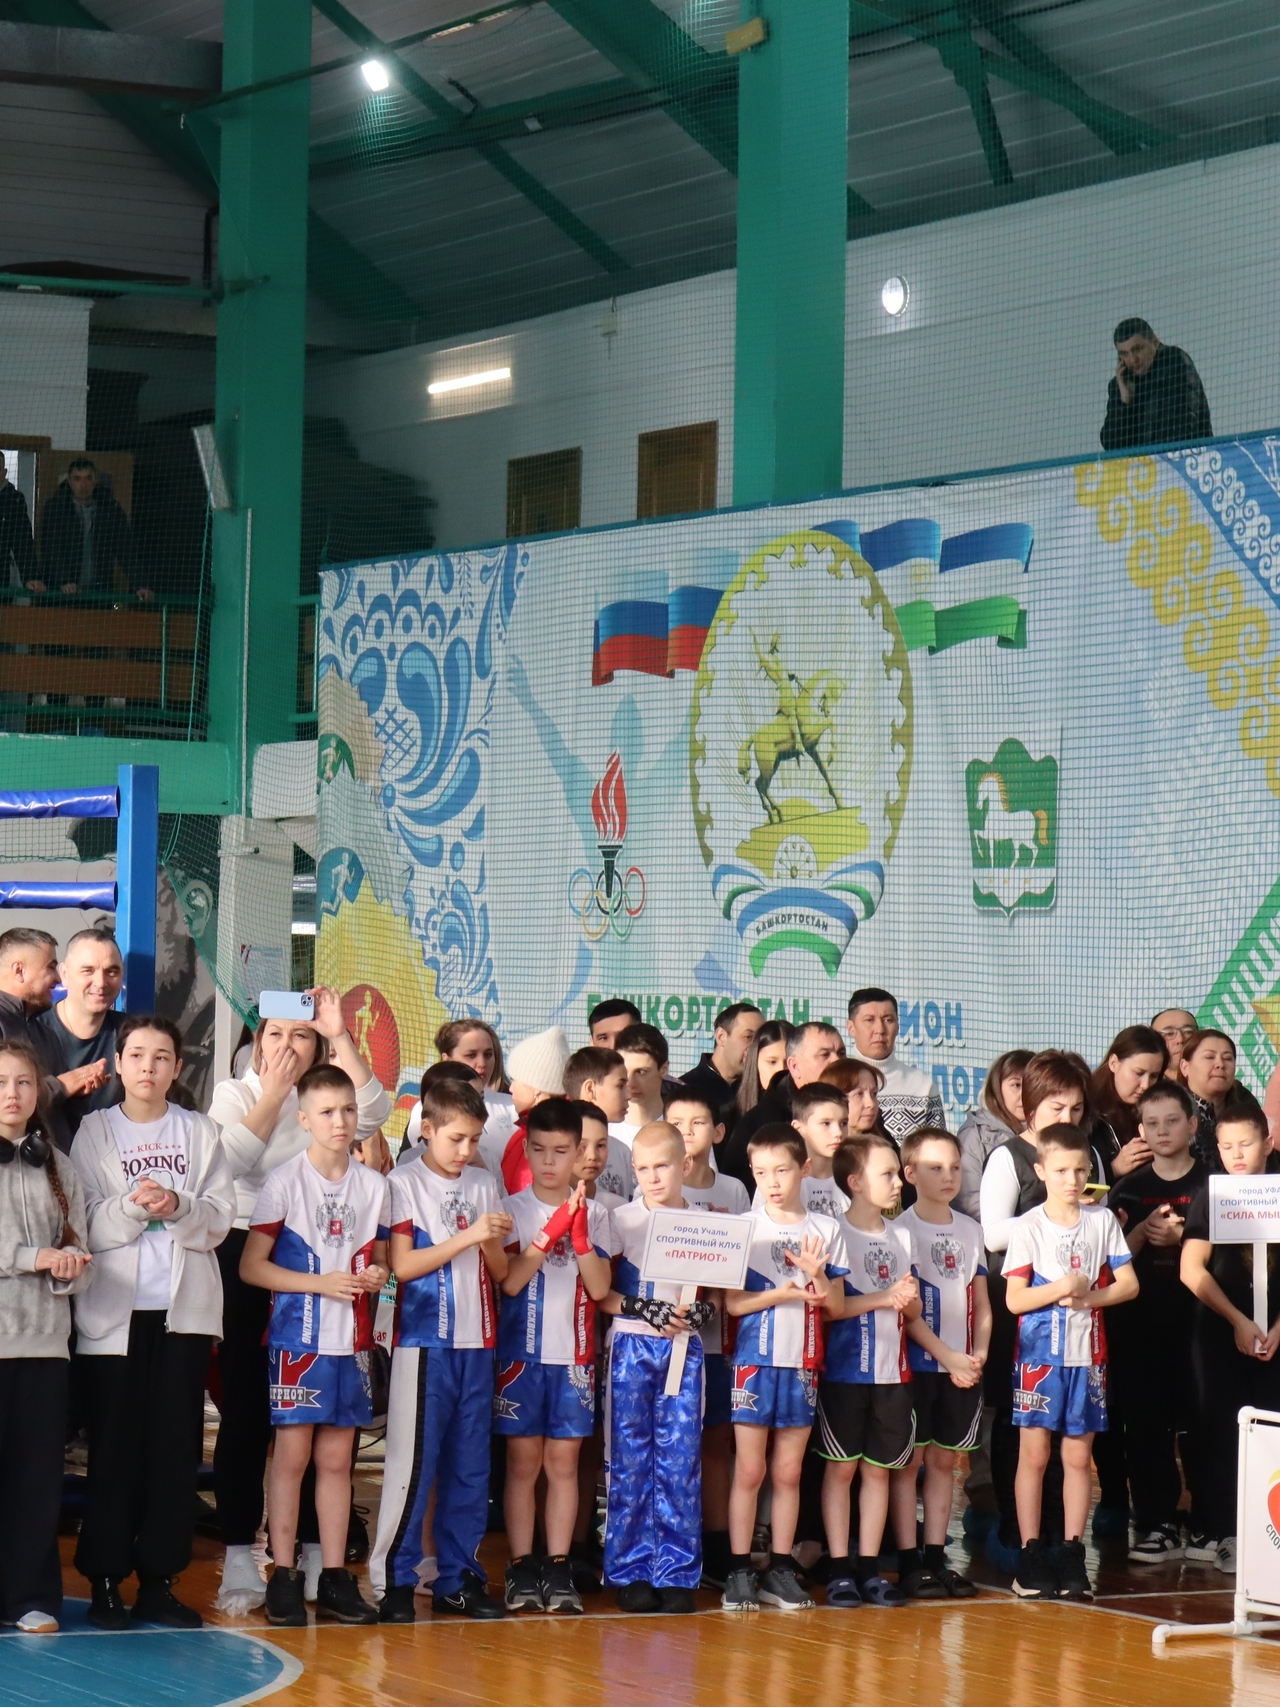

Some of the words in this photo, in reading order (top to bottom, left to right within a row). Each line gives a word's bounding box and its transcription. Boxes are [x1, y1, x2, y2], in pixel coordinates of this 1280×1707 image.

[756, 914, 828, 935] БАШКОРТОСТАН
[137, 1143, 162, 1152] KICK
[121, 1154, 186, 1181] BOXING
[1220, 1197, 1278, 1208] СПОРТИВНЫЙ
[1239, 1187, 1263, 1196] город
[1220, 1210, 1255, 1221] «СИЛА
[674, 1225, 698, 1236] город
[701, 1227, 728, 1237] Учалы
[656, 1235, 716, 1248] СПОРТИВНЫЙ
[718, 1241, 741, 1250] КЛУБ
[355, 1254, 365, 1276] RUS
[665, 1249, 728, 1263] «ПАТРИОТ»
[480, 1283, 492, 1338] KICKBOXING
[925, 1286, 933, 1314] RUSSIA
[438, 1286, 448, 1340] KICKBOXING
[526, 1303, 537, 1354] KICKBOXING
[577, 1306, 588, 1356] KICKBOXING
[807, 1314, 815, 1359] KICKBOXING
[1051, 1311, 1059, 1356] KICKBOXING
[860, 1326, 869, 1373] KICKBOXING
[270, 1388, 303, 1400] ТРИОТ
